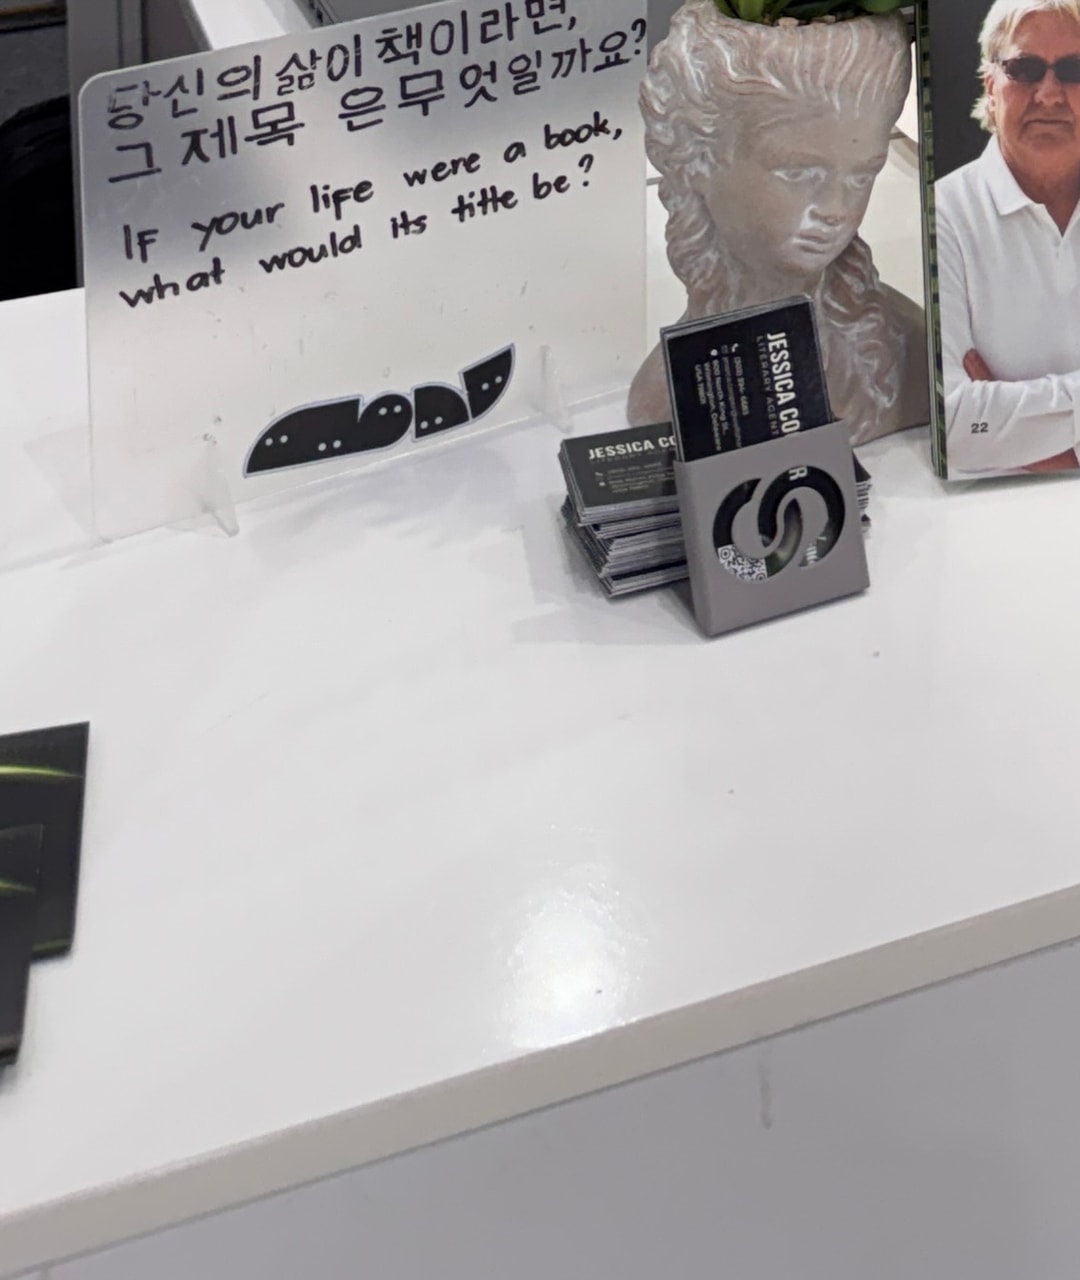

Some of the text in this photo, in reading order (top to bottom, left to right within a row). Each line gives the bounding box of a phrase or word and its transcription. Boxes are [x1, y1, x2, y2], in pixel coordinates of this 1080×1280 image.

[106, 53, 261, 130] 당신의
[275, 35, 361, 97] 삶이
[108, 144, 162, 183] 그
[180, 99, 305, 167] 제목
[191, 197, 287, 253] your
[402, 153, 482, 188] were
[502, 140, 528, 164] a
[542, 111, 623, 150] book,
[119, 257, 228, 308] what
[258, 225, 363, 275] would
[389, 208, 429, 241] its
[756, 335, 772, 393] LITERARY
[766, 331, 797, 407] JESSICA
[588, 437, 657, 462] JESSICA
[969, 421, 989, 435] 22
